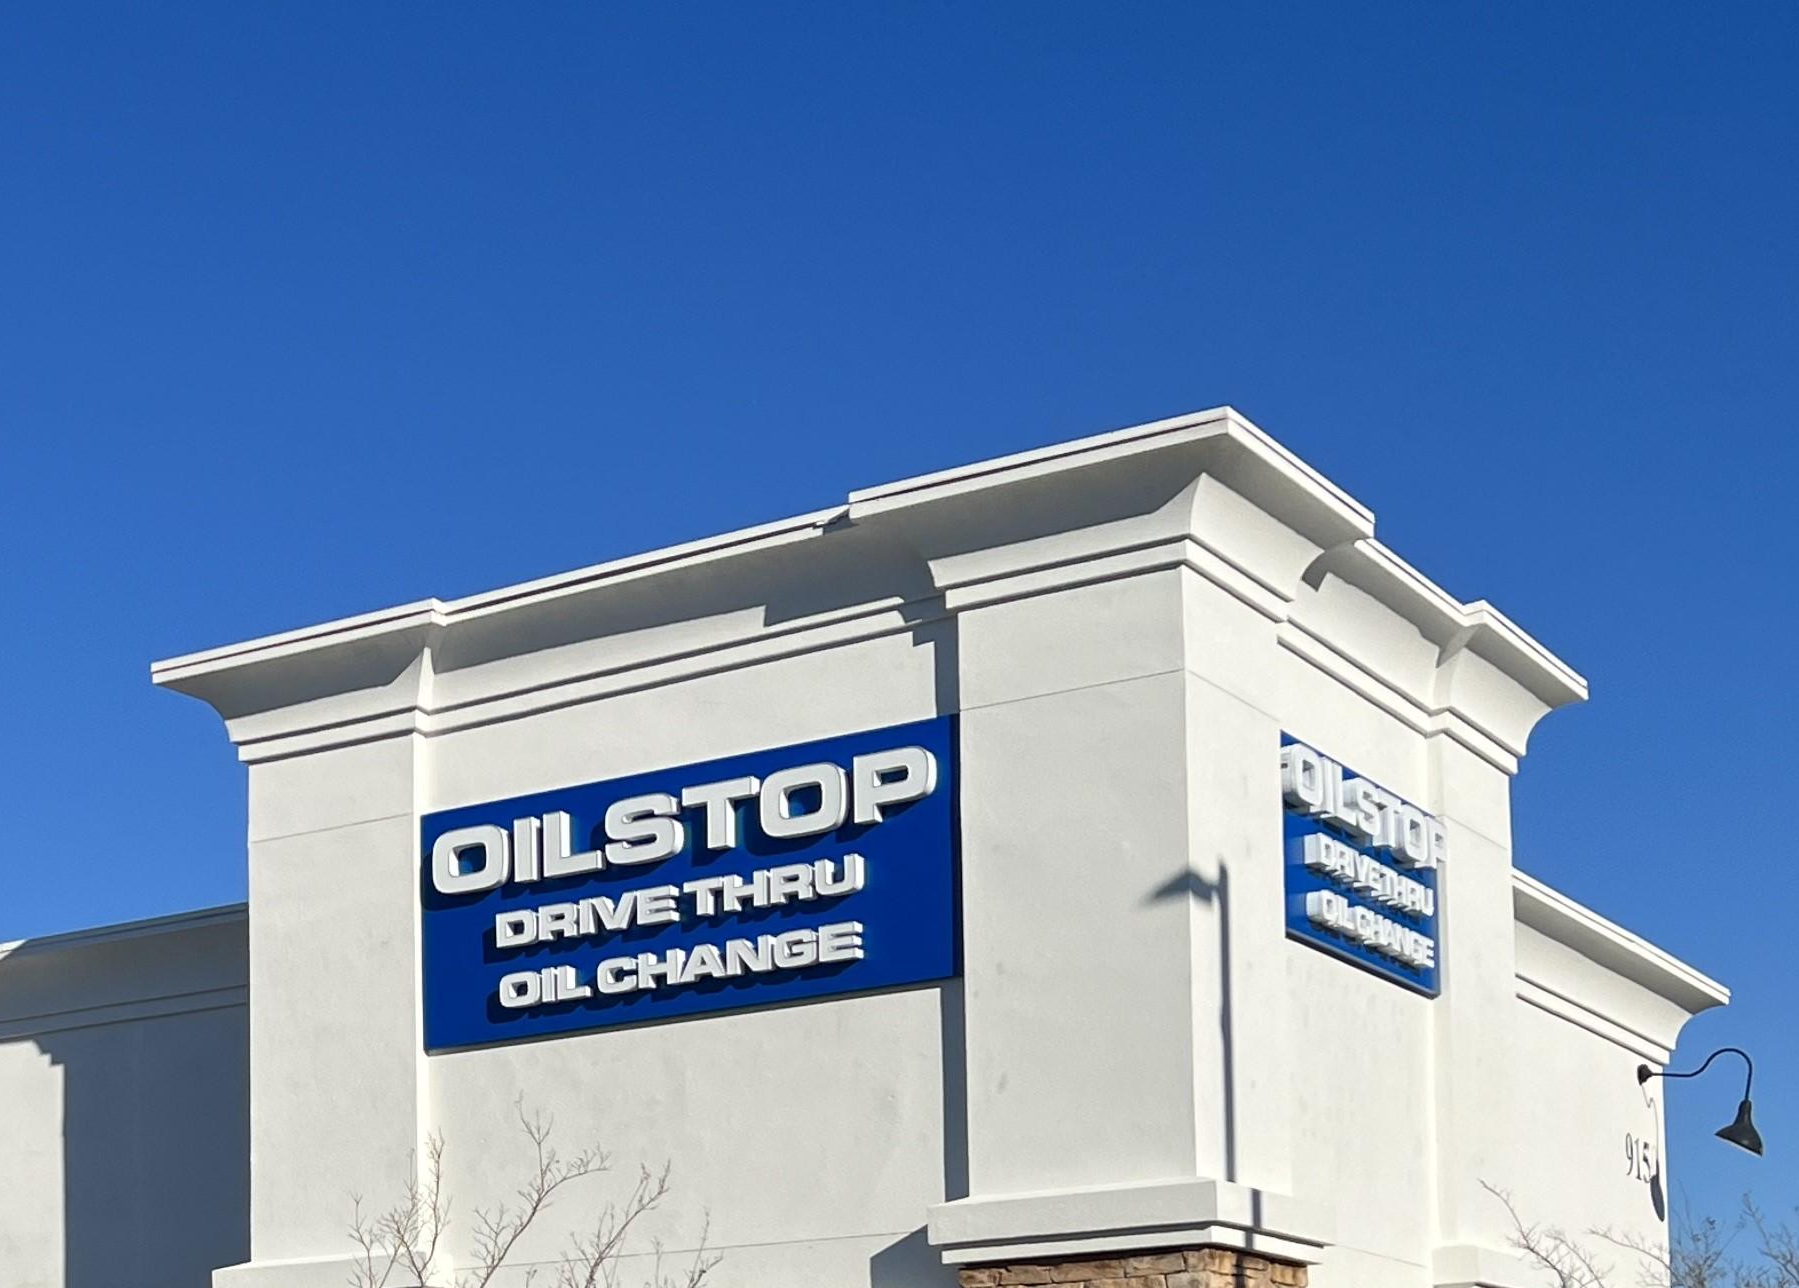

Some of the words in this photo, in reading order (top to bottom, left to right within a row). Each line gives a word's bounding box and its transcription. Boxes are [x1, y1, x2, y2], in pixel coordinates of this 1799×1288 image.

[432, 745, 937, 894] OILSTOP
[1281, 743, 1448, 868] OILSTOP
[496, 885, 680, 948] DRIVE
[683, 853, 865, 916] THRU
[1305, 832, 1381, 893] DRIVE
[1374, 865, 1434, 916] THRU
[500, 965, 591, 1009] OIL
[597, 921, 865, 995] CHANGE
[1306, 889, 1354, 930] OIL
[1353, 905, 1434, 968] CHANGE
[1625, 1132, 1651, 1184] 915
